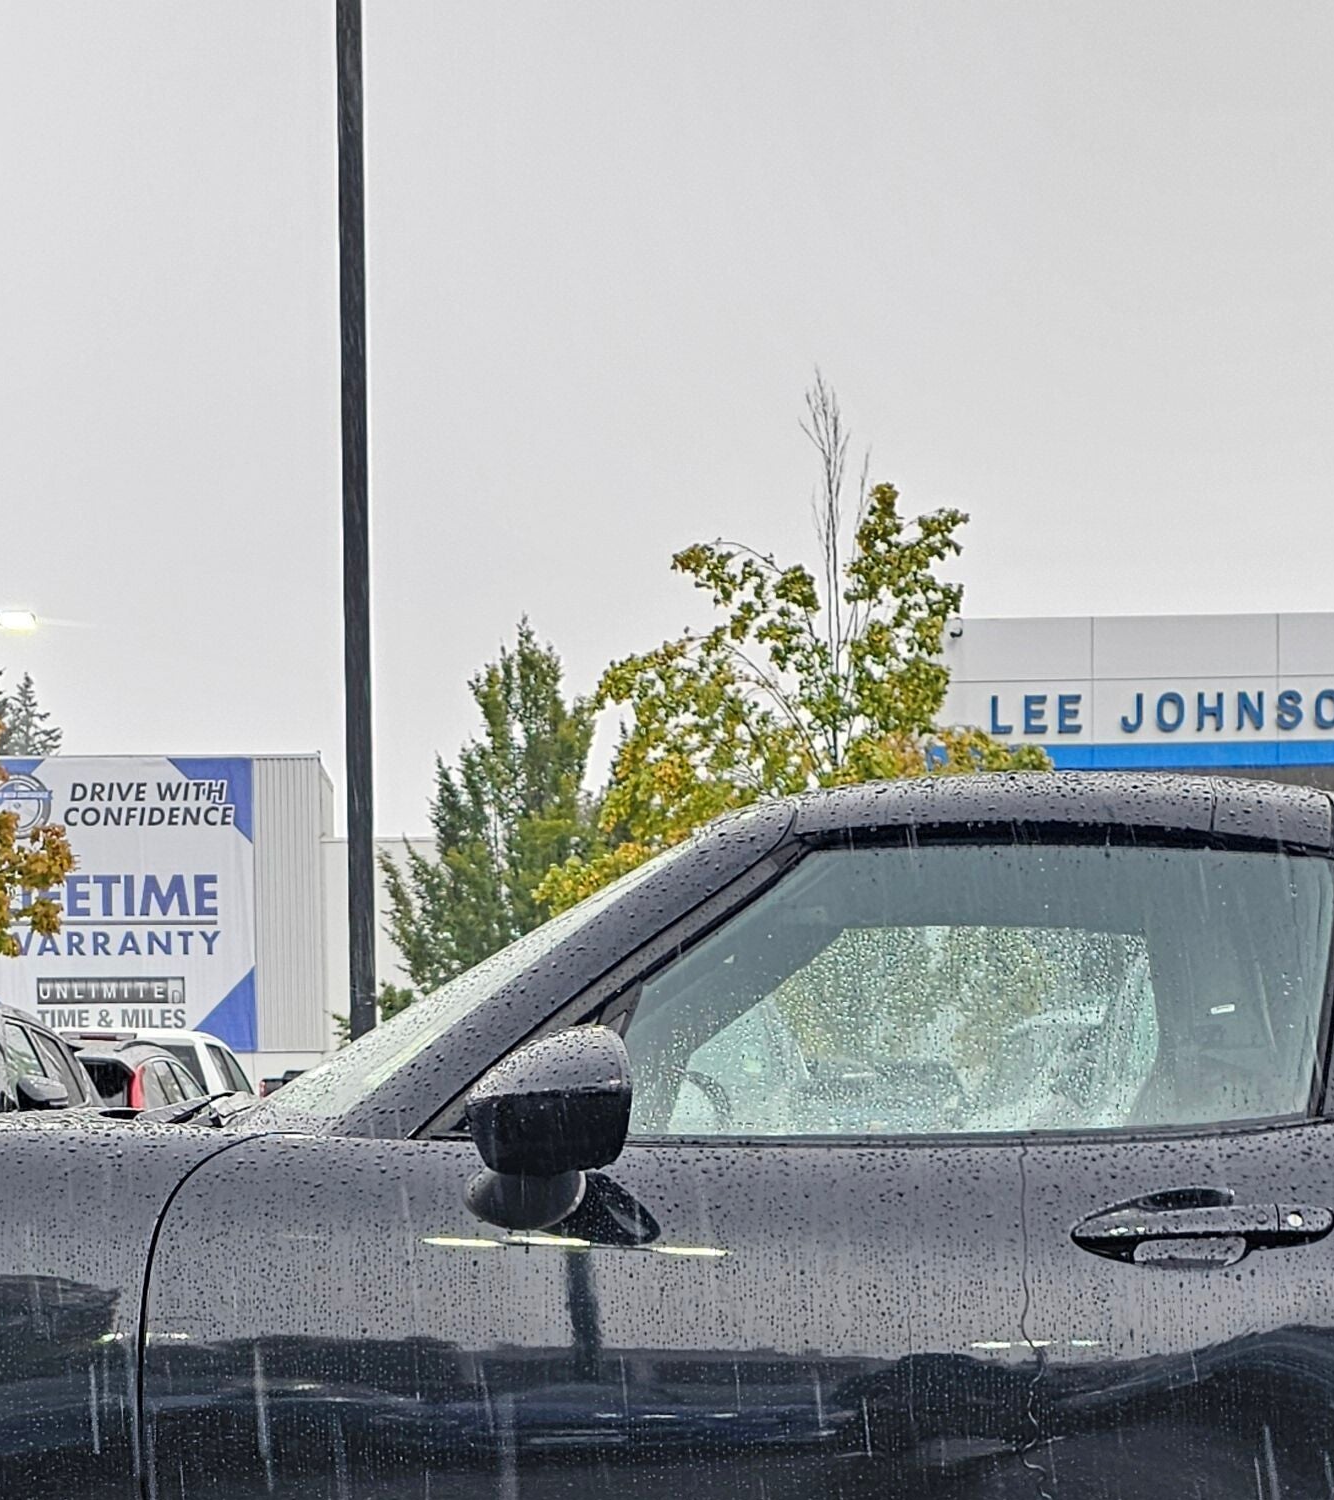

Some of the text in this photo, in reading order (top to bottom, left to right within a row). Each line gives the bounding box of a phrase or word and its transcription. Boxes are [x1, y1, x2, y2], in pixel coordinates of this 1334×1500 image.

[991, 694, 1082, 735] LEE
[70, 782, 147, 802] DRIVE
[156, 781, 225, 802] WITH
[64, 806, 235, 827] CONFIDENCE
[9, 874, 218, 917] ETIME
[39, 982, 182, 1004] UNLIMITED
[38, 1008, 186, 1028] TIME & MILES
